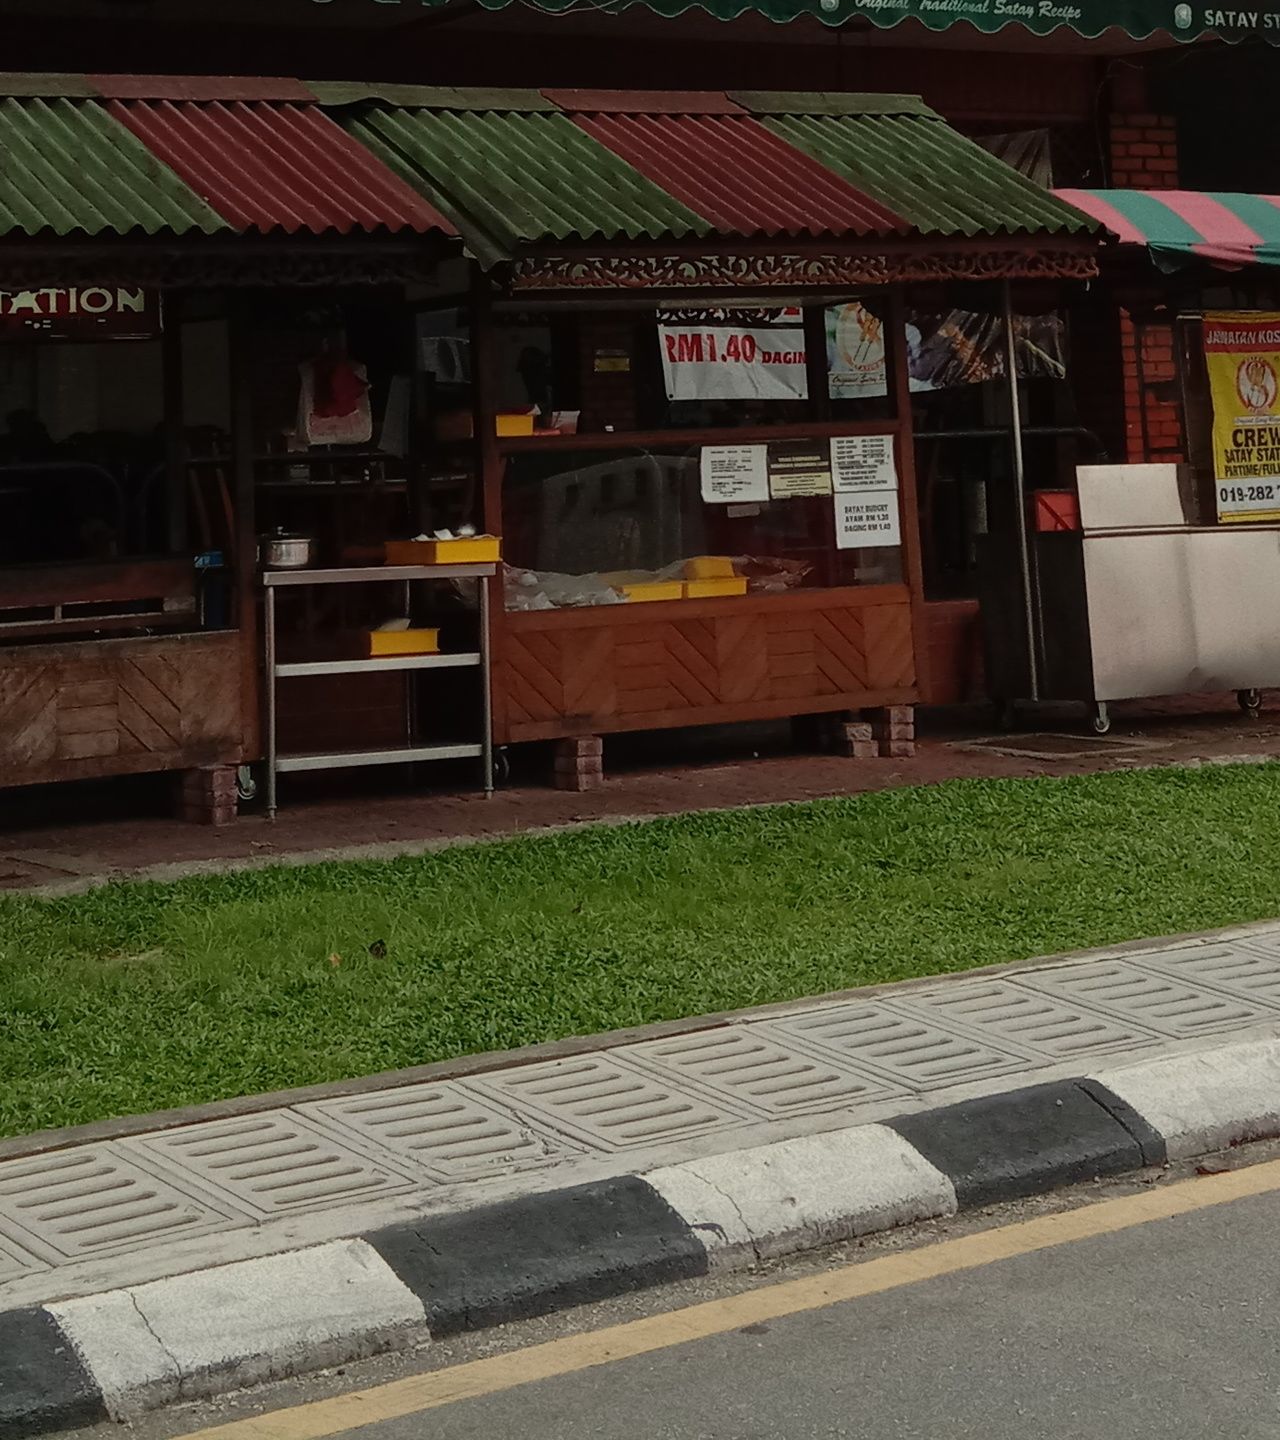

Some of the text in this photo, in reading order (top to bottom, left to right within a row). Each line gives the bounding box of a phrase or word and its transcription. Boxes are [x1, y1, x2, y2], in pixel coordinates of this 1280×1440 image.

[1039, 0, 1082, 20] Recipe
[1205, 9, 1258, 28] SATAY
[1206, 329, 1257, 345] JAWATAN
[1224, 448, 1253, 464] SATAY
[1220, 486, 1274, 502] 019-282
